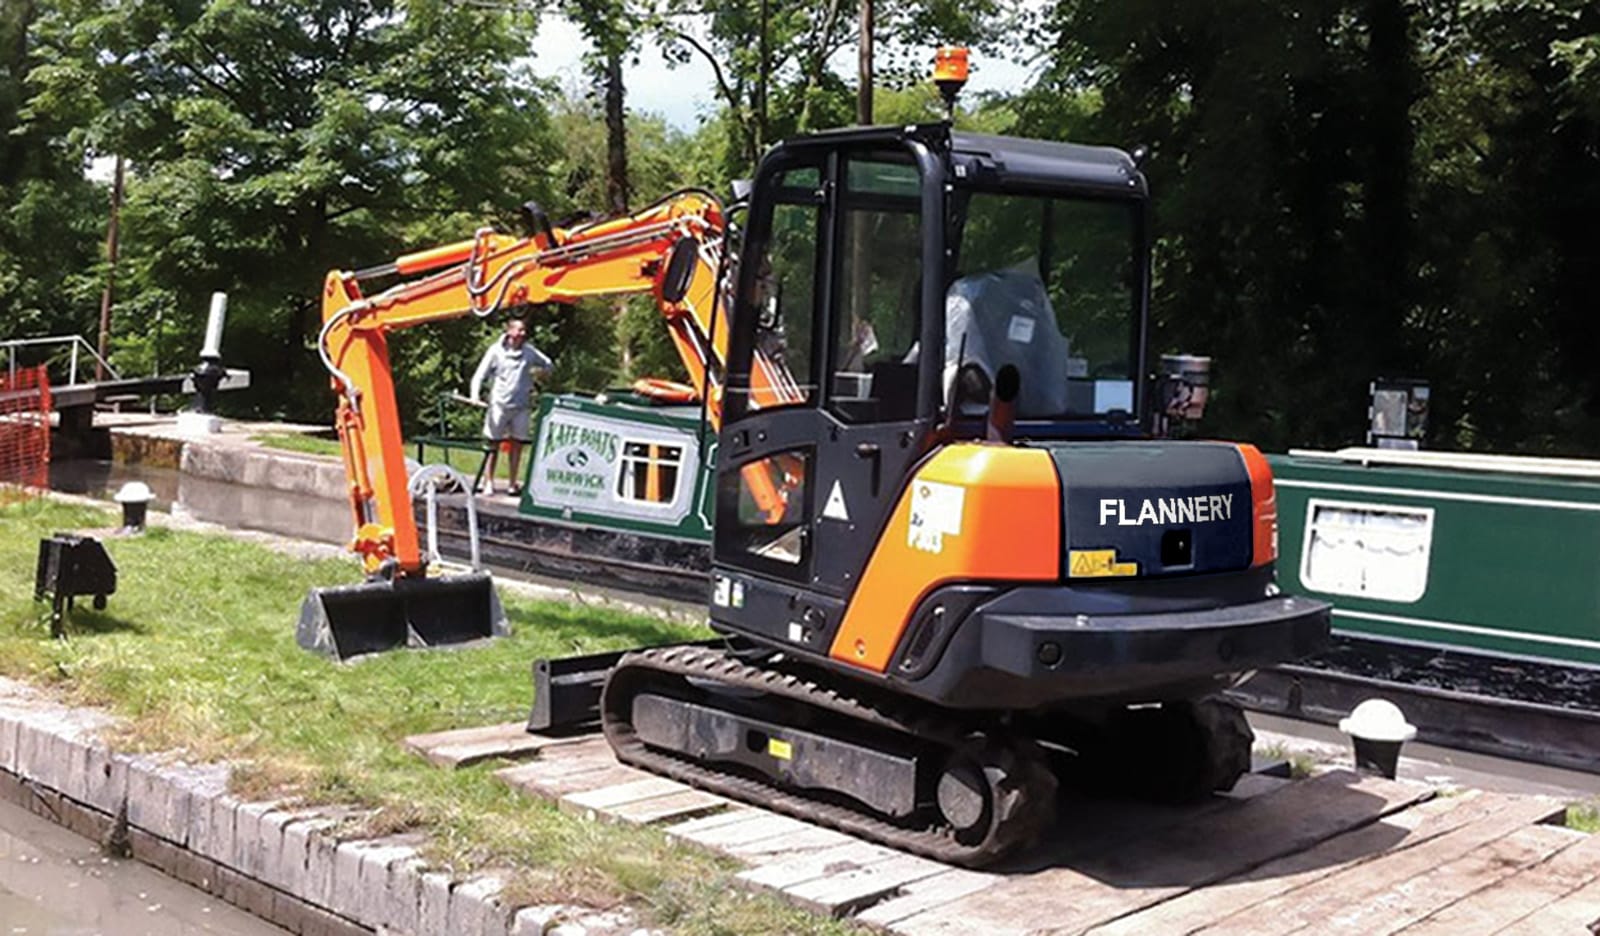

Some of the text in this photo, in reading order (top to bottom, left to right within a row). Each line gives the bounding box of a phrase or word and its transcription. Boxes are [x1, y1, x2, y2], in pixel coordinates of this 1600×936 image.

[543, 421, 619, 464] KATE BOATS
[546, 469, 606, 489] WARWICK
[1099, 493, 1233, 526] FLANNERY
